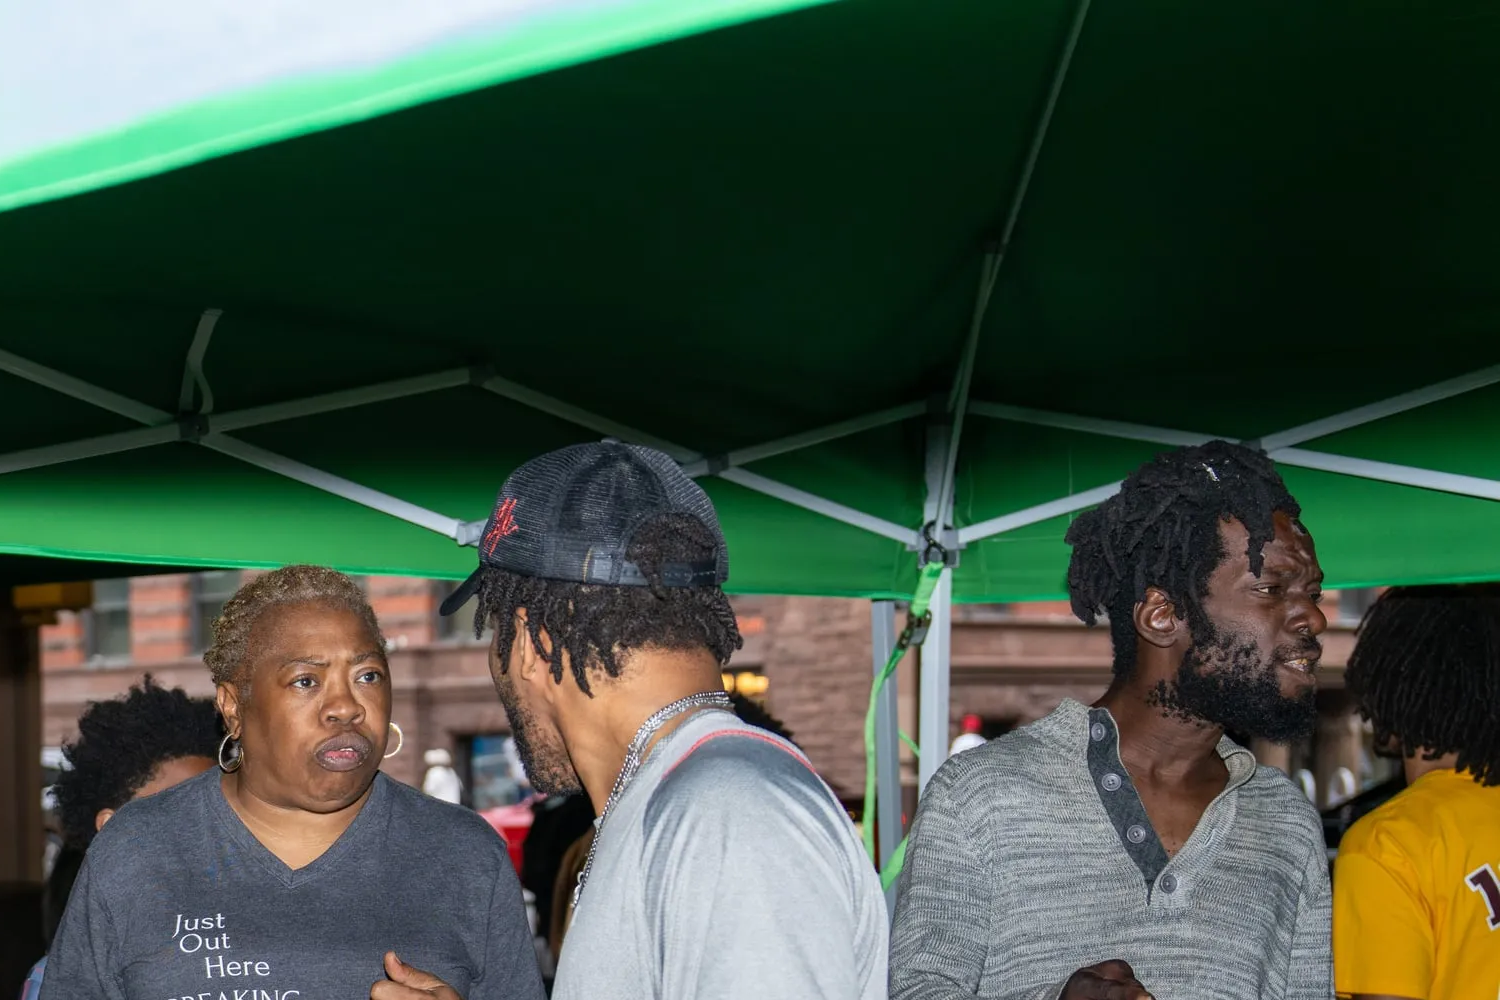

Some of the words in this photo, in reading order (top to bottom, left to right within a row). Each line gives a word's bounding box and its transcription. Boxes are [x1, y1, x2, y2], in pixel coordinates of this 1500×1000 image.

[172, 912, 226, 938] Just
[179, 932, 231, 953] Out
[204, 955, 271, 979] Here
